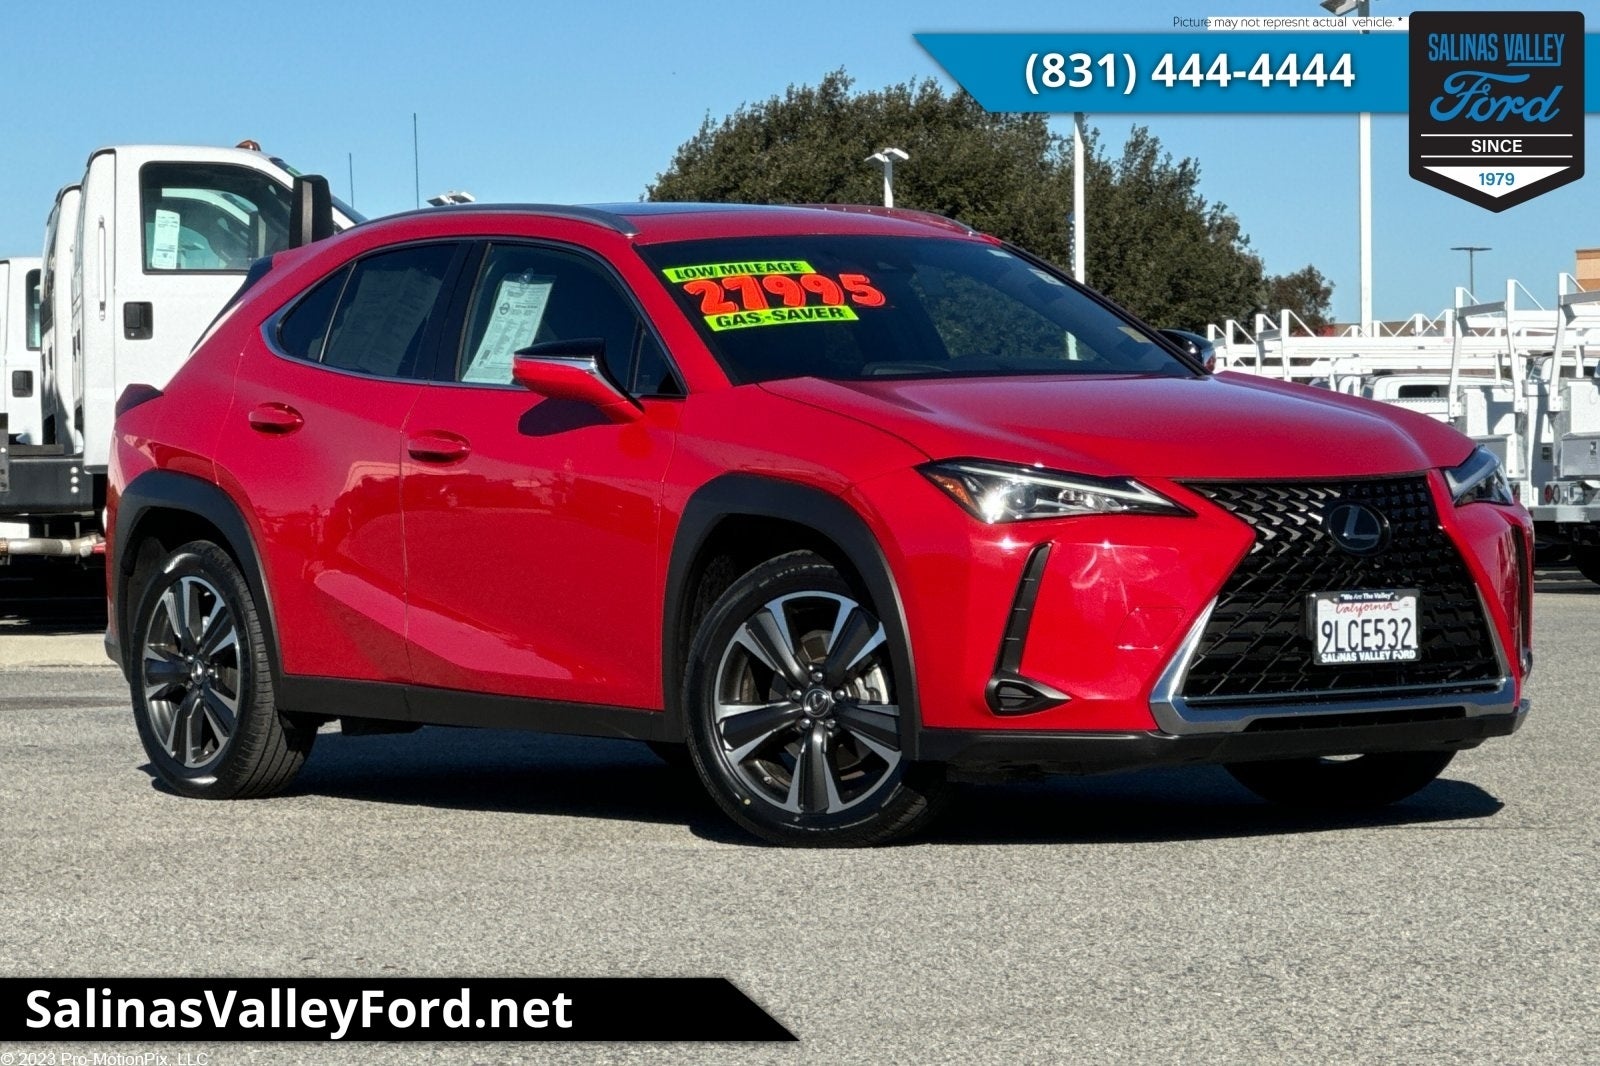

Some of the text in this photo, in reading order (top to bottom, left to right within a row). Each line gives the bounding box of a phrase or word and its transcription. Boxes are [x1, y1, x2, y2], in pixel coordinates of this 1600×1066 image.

[674, 262, 803, 281] LOW MILEAGE
[683, 273, 886, 316] 27995
[716, 307, 845, 329] GAS-SAVER
[1335, 602, 1400, 618] California
[1321, 617, 1412, 654] 9LCE532
[1321, 649, 1416, 663] SALINAS VALLEY FORD
